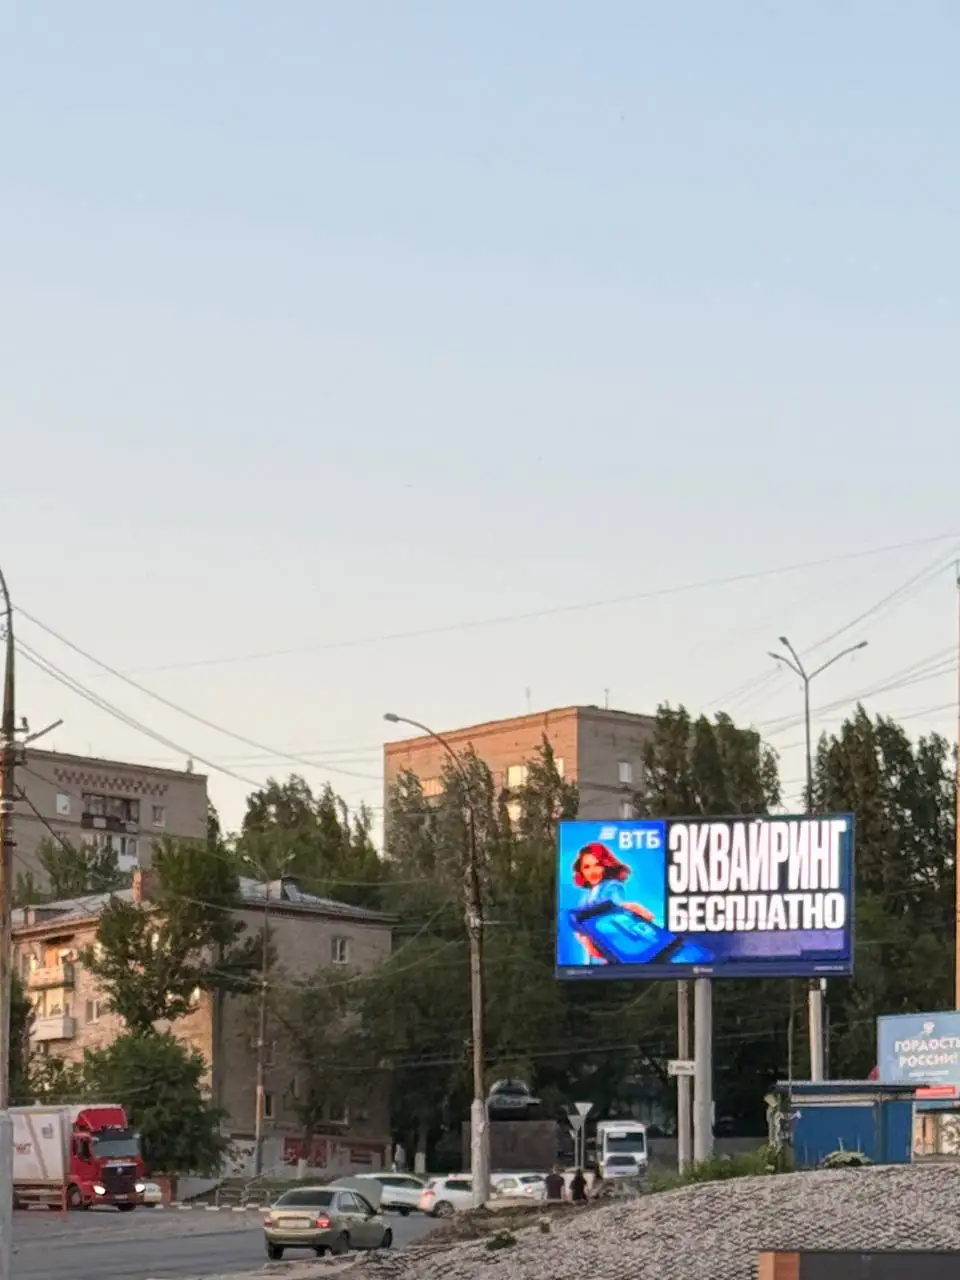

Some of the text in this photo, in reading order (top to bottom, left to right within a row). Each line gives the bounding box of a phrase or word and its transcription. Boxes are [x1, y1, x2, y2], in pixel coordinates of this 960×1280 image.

[619, 829, 661, 849] ВТБ
[668, 818, 847, 892] ЭКВАЙРИНГ
[668, 892, 846, 932] БЕСПЛАТНО
